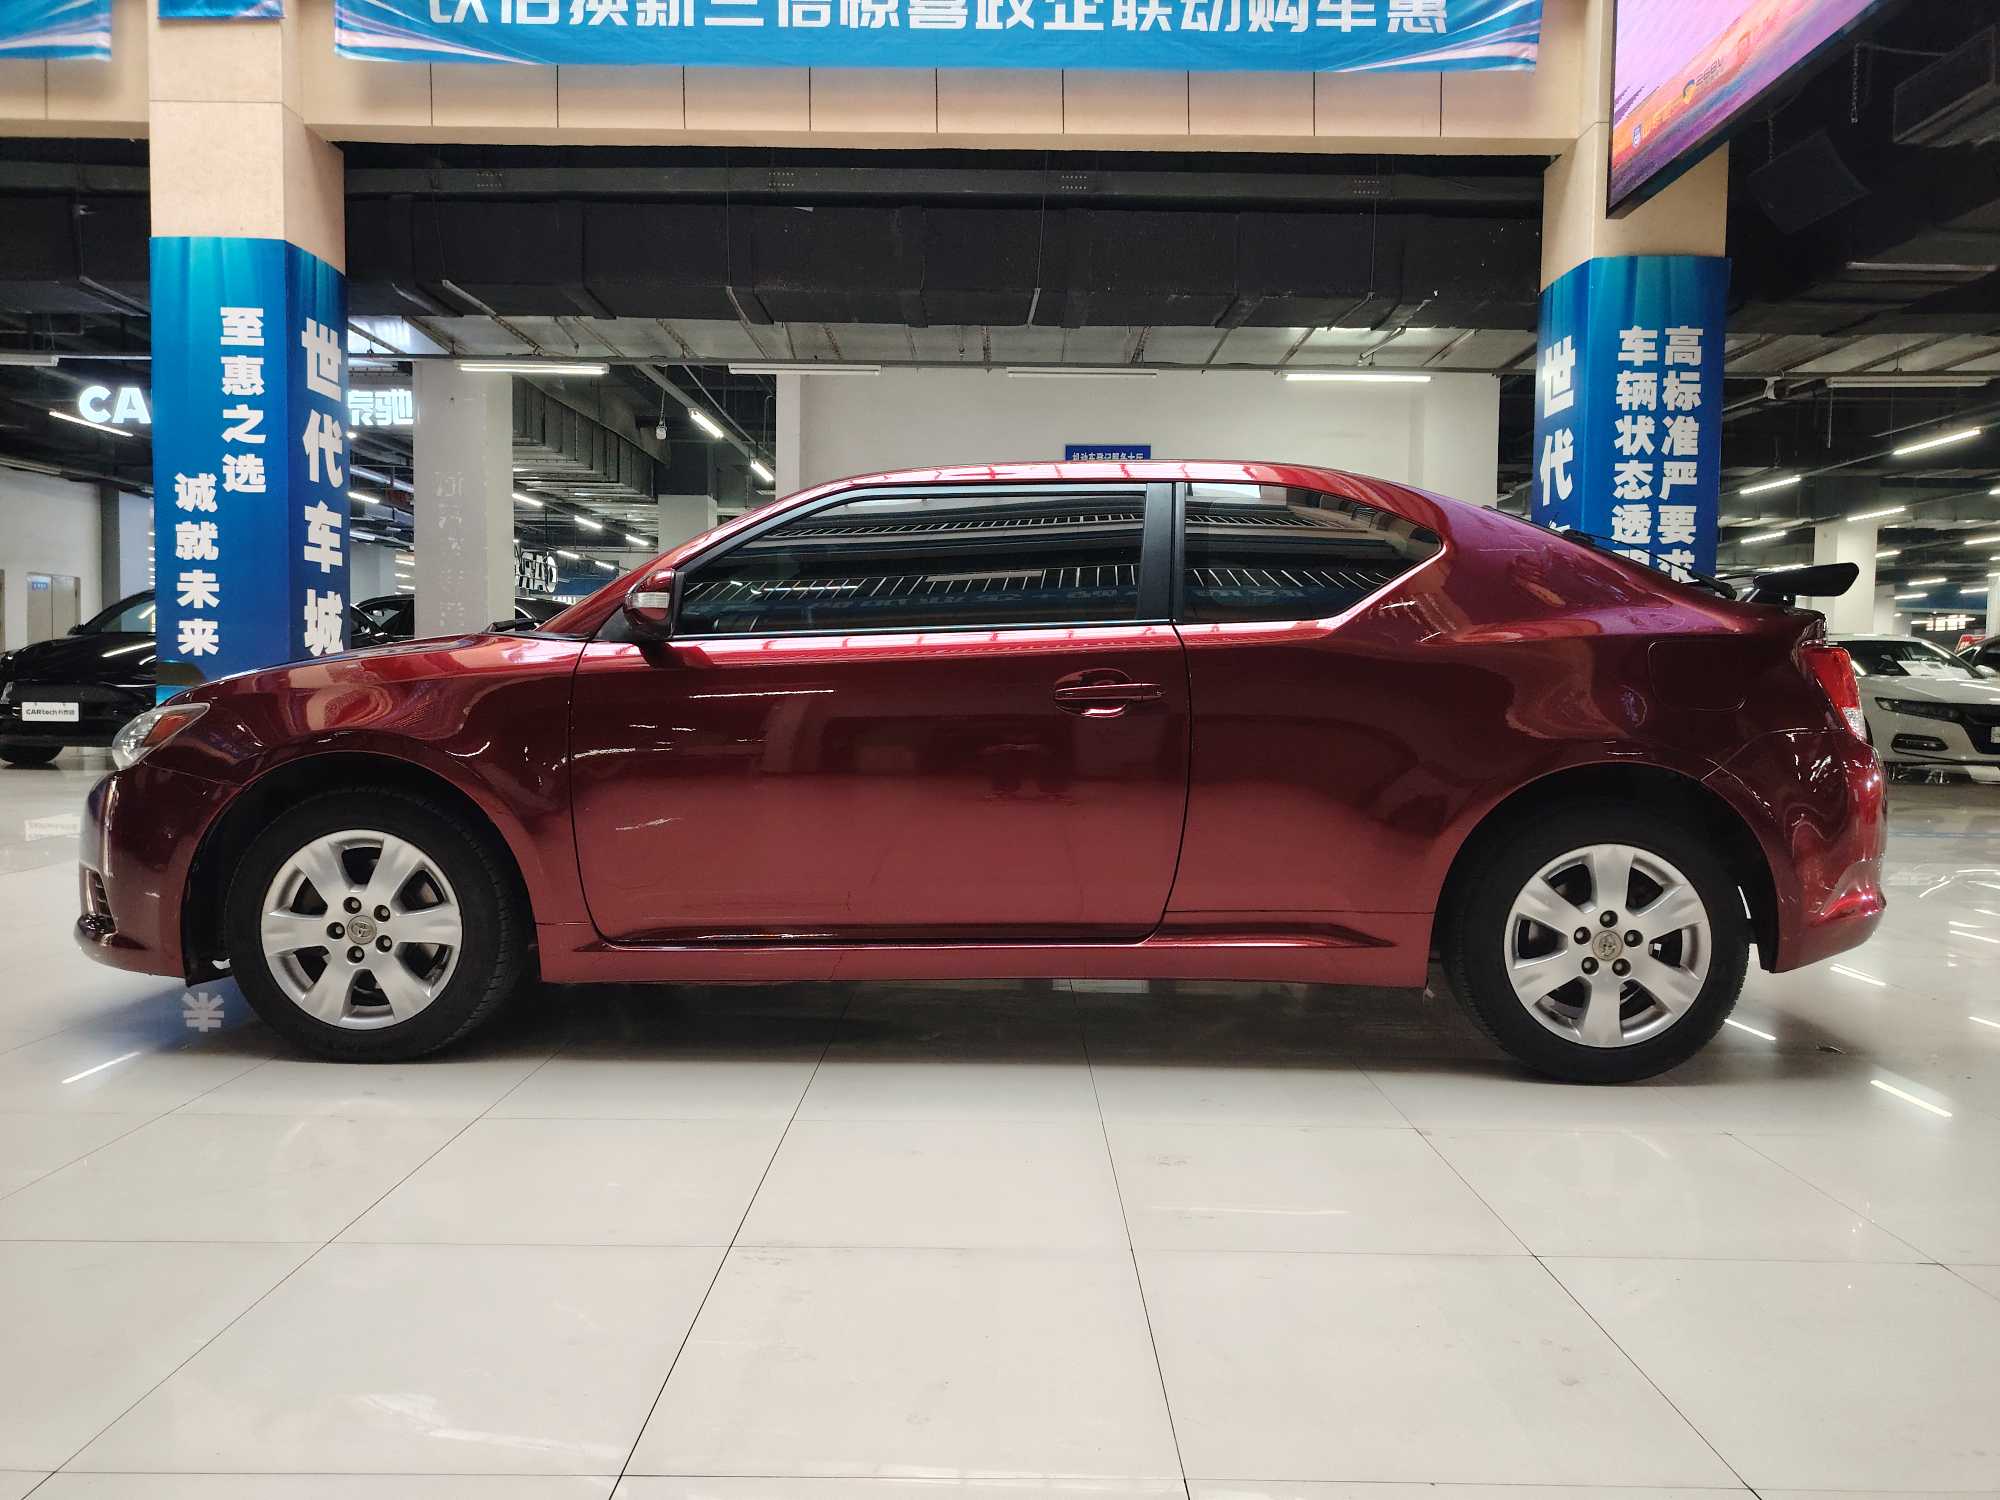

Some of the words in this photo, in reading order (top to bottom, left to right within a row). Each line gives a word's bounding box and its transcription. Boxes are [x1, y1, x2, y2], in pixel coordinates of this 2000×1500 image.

[220, 306, 267, 493] 至惠之选
[301, 317, 344, 656] 世代车城
[1540, 335, 1576, 534] 世代
[1657, 325, 1704, 583] 高标准严要求
[174, 472, 221, 656] 诚就未来
